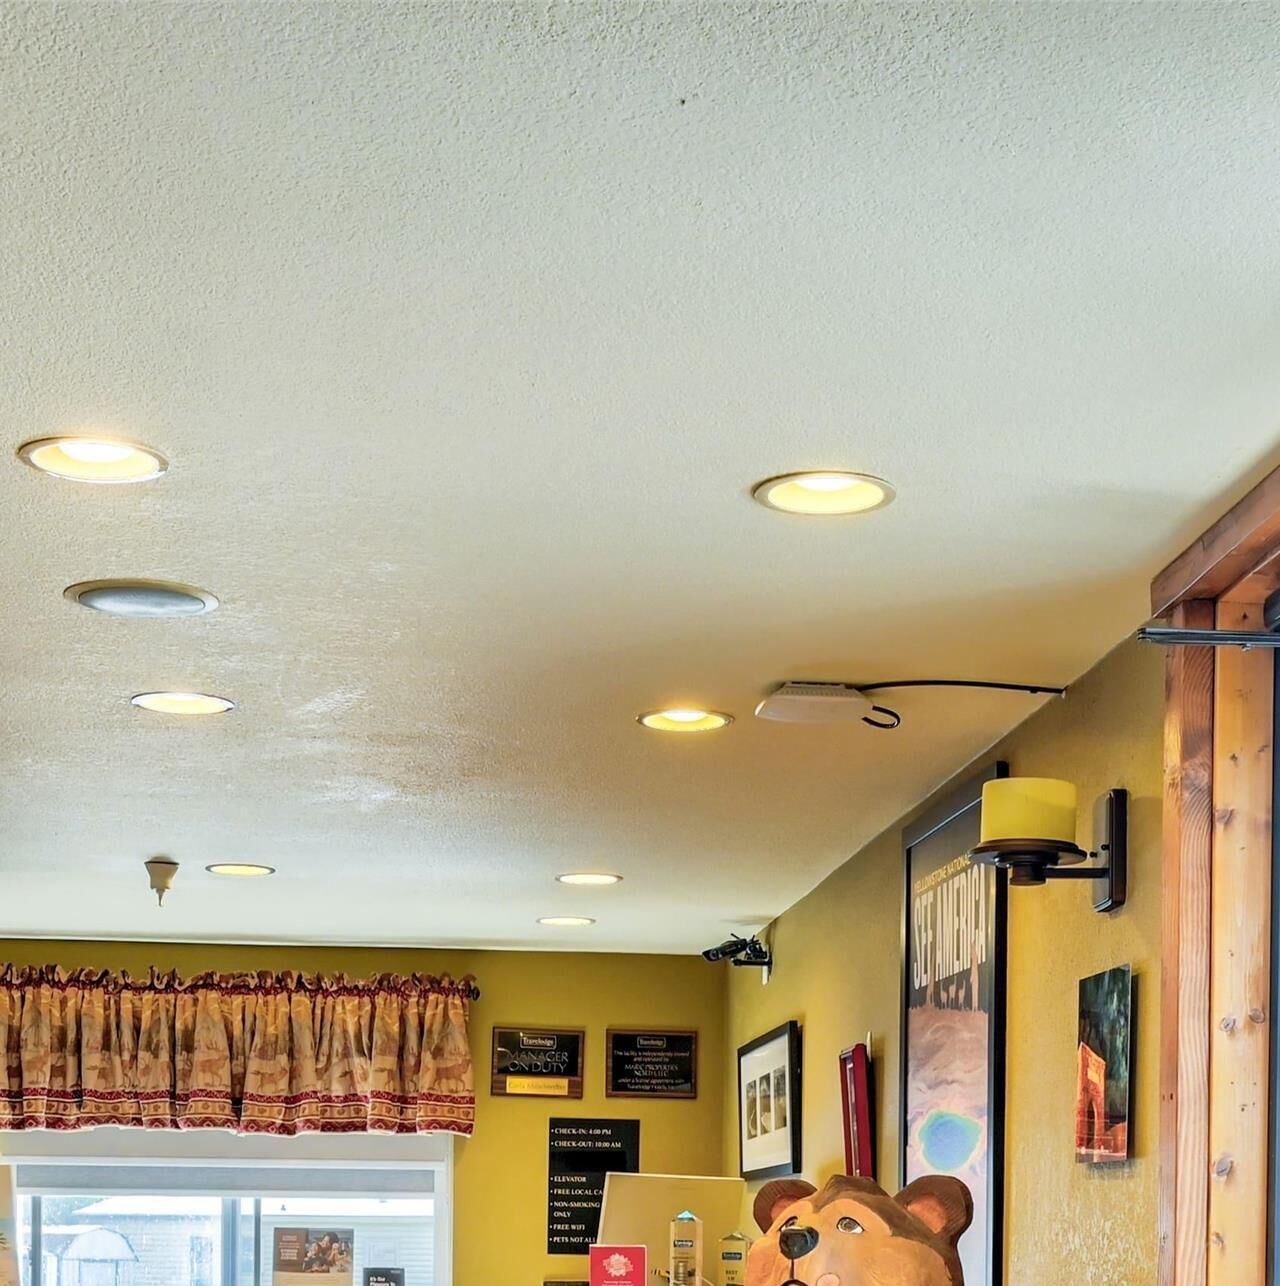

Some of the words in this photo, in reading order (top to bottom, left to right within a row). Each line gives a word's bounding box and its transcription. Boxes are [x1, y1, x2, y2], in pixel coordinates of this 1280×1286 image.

[914, 865, 948, 894] YELLOWSTONE
[914, 889, 934, 990] SEE
[936, 862, 986, 982] AMERICA
[523, 1037, 554, 1046] Travelodge
[506, 1051, 568, 1062] MANAGER
[508, 1060, 529, 1071] ON
[532, 1061, 566, 1072] DUTY
